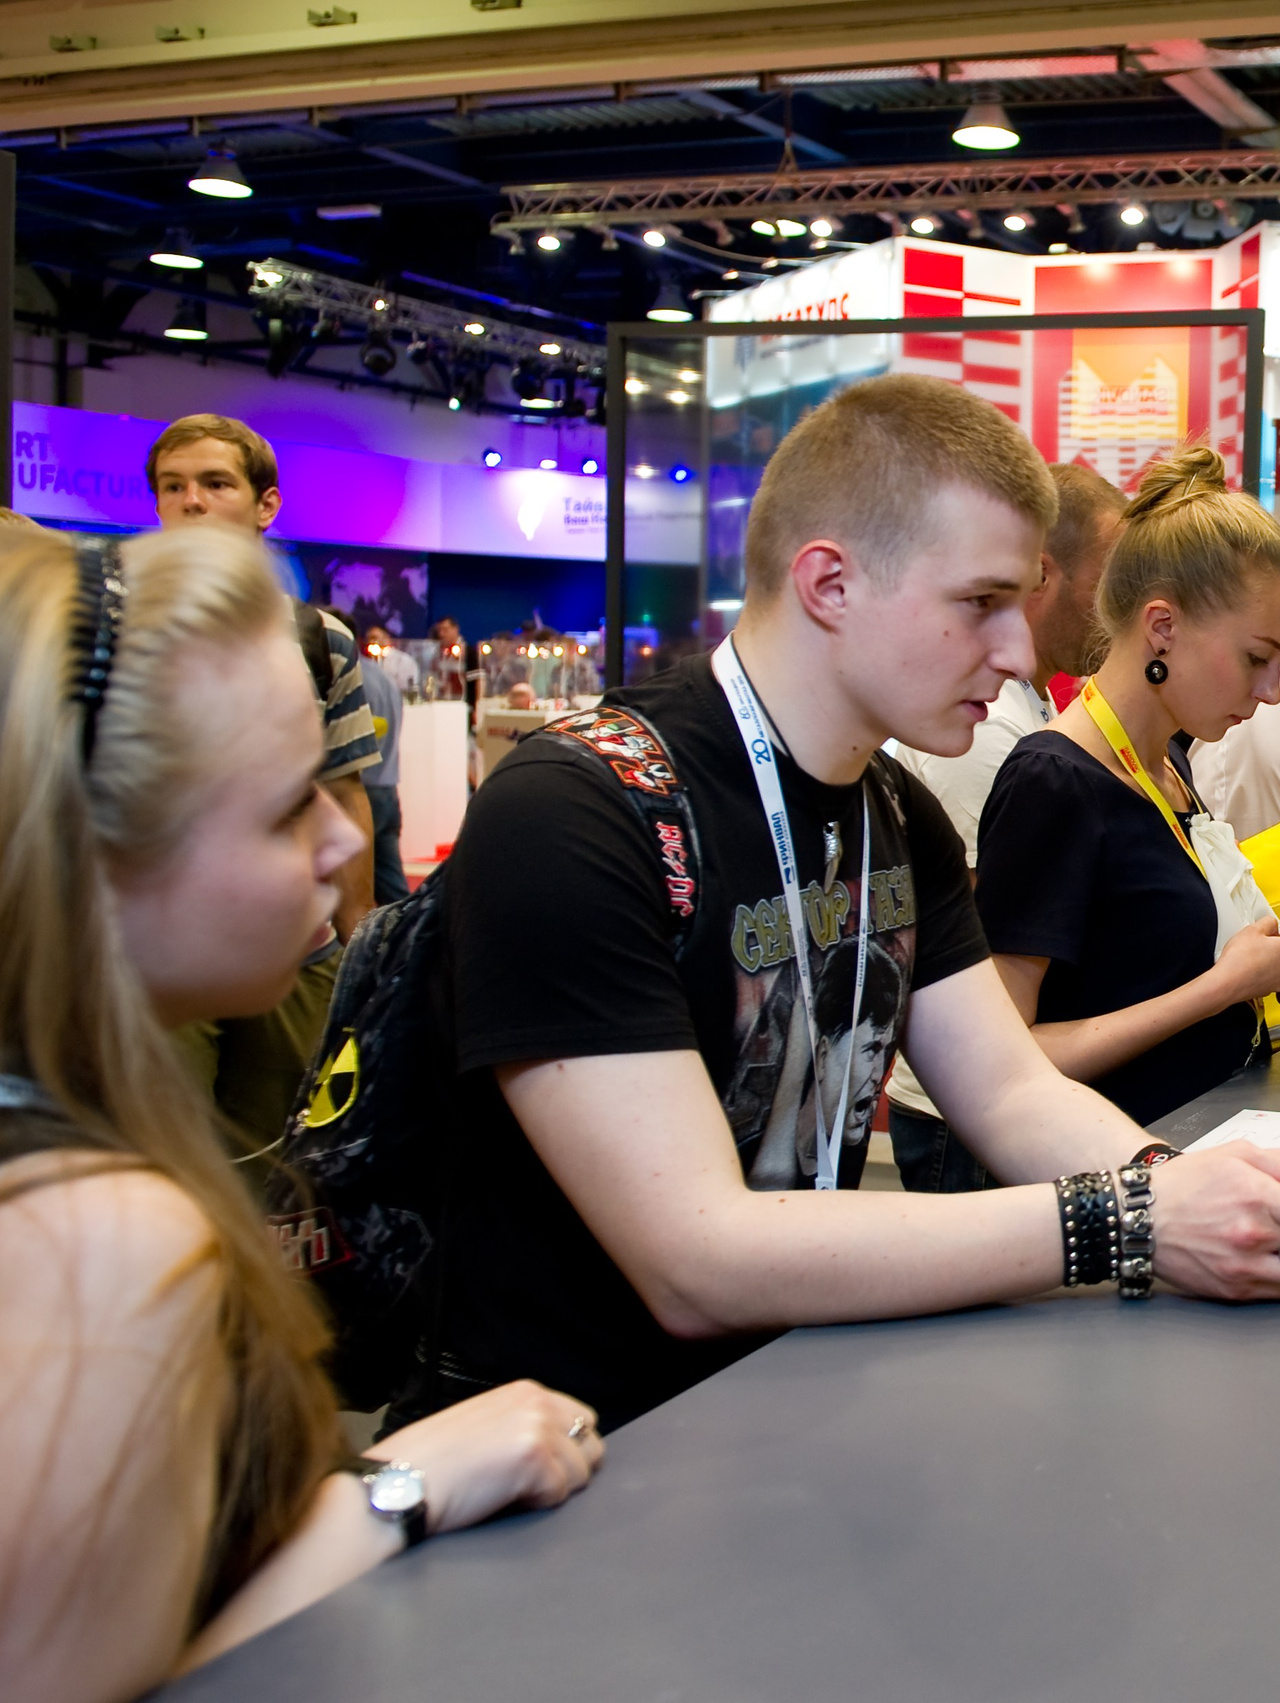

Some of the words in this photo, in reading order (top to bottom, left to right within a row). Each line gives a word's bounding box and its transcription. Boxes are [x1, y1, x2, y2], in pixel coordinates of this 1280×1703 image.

[750, 738, 772, 765] 20
[656, 820, 696, 918] AC/DC
[770, 811, 790, 865] ФИНВАЛ
[731, 880, 851, 973] СЕКОР
